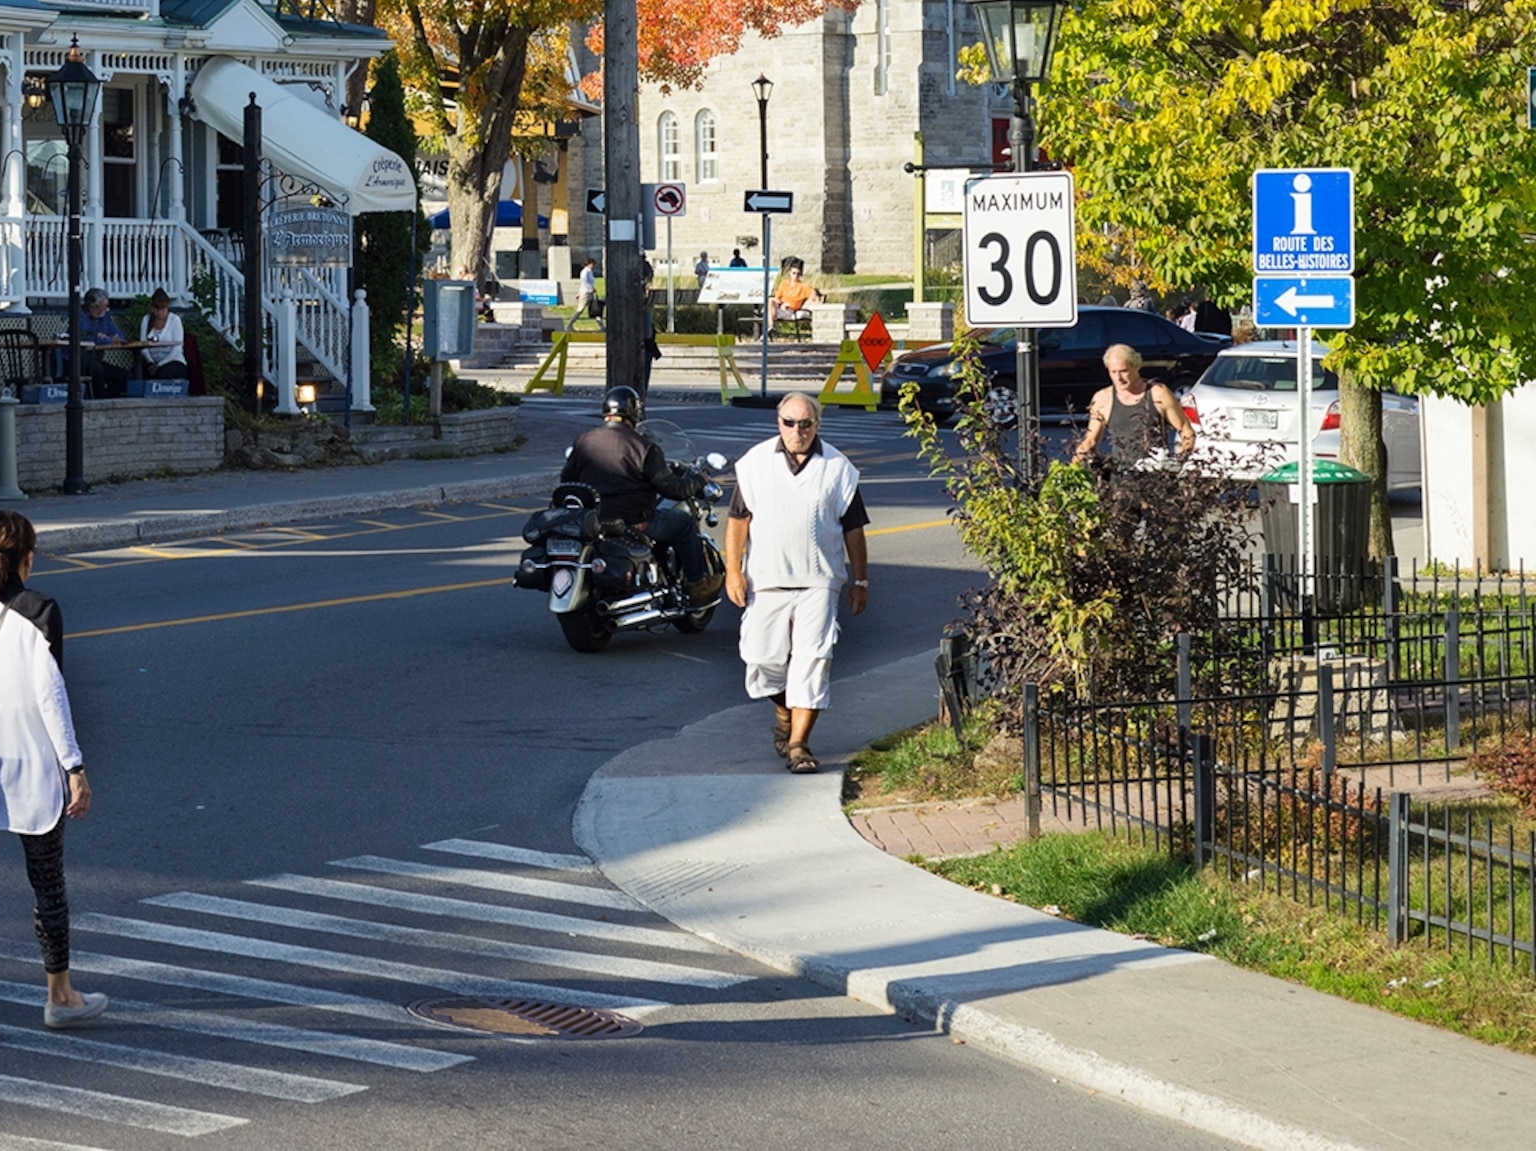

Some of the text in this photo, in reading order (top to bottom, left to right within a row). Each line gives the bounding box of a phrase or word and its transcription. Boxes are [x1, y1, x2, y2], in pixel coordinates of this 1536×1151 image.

[973, 192, 1063, 211] MAXIMUM
[1272, 236, 1335, 252] ROUTE DES
[977, 230, 1062, 306] 30
[1259, 253, 1349, 269] BELLES-HISTOIRES
